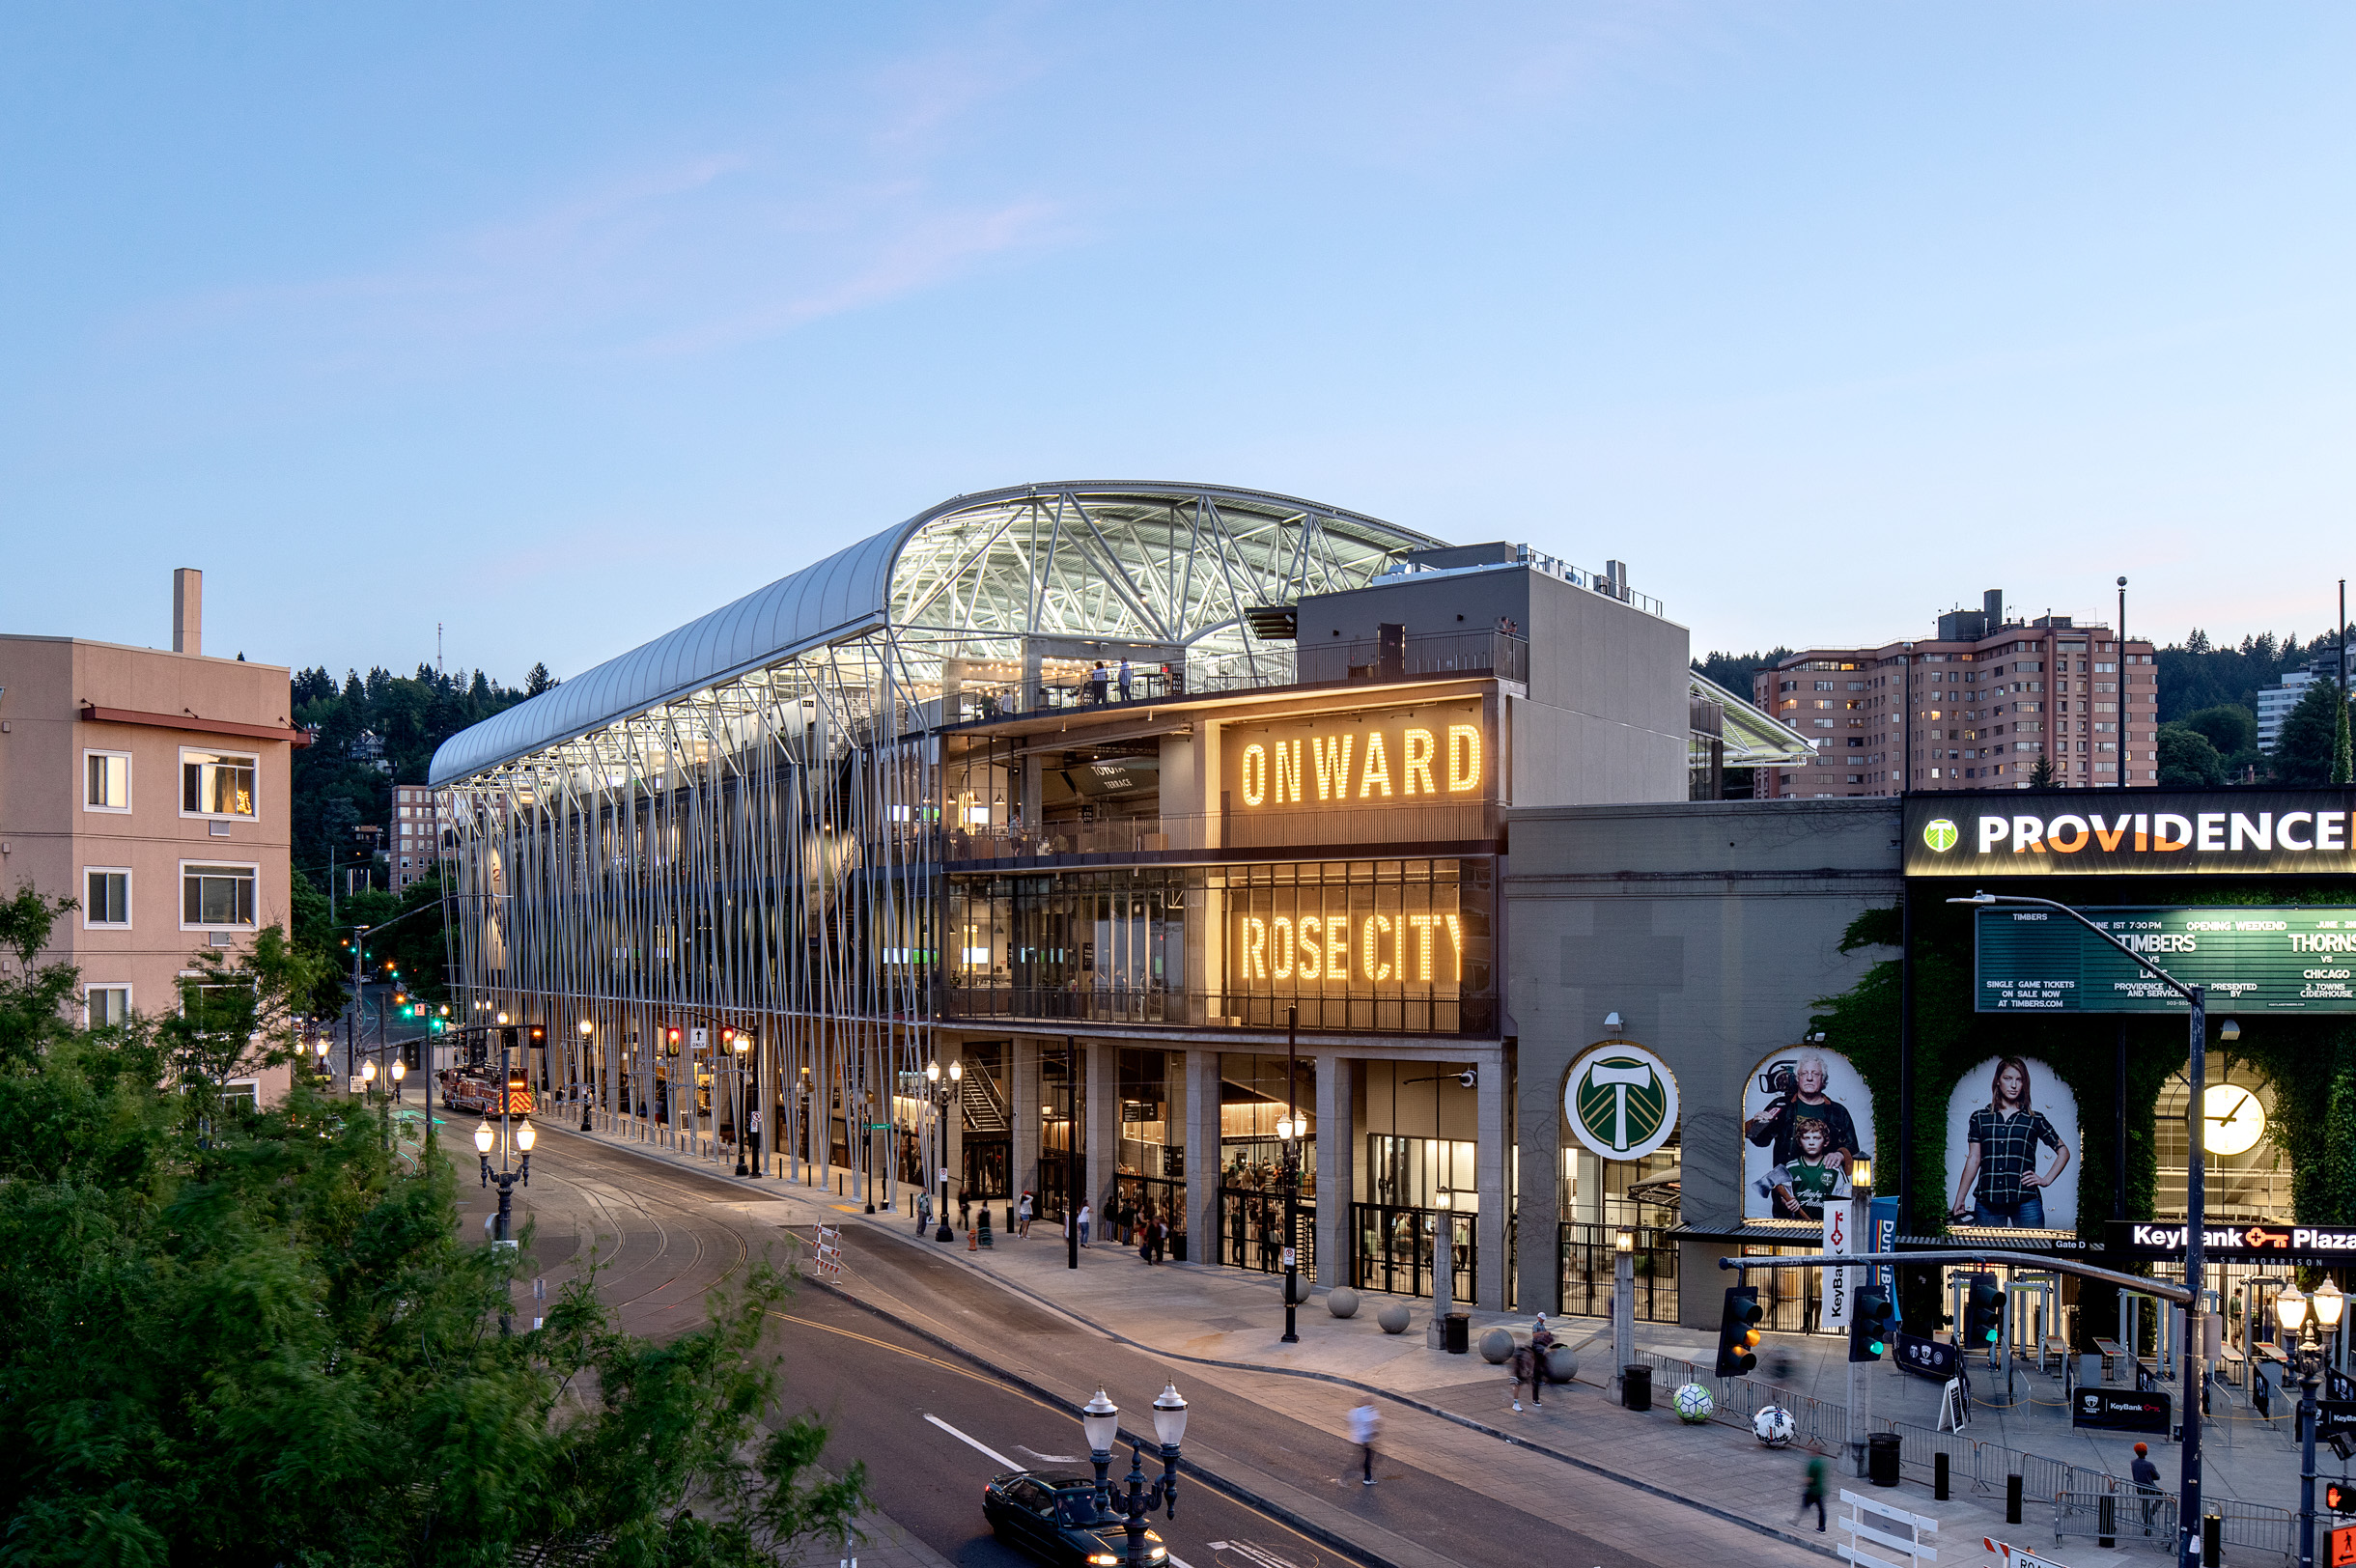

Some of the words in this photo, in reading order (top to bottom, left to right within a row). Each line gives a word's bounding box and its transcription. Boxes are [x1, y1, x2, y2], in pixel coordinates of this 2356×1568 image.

[1242, 724, 1481, 807] ONWARD
[1104, 778, 1132, 789] TERRACE
[1978, 811, 2345, 854] PROVIDENCE
[2186, 921, 2231, 931] OPENING
[2235, 920, 2287, 931] WEEKEND
[2315, 920, 2339, 929] JUNE
[1242, 915, 1348, 981] ROSE
[1363, 913, 1461, 982] CITY
[2117, 934, 2197, 953] TIMBERS
[2147, 955, 2160, 964] VS
[2320, 955, 2333, 964] VS
[2303, 968, 2351, 979] CHICAGO
[2114, 982, 2164, 991] PROVIDENCE
[2169, 982, 2200, 991] ALTH
[2210, 983, 2258, 992] PRESENTED
[2300, 990, 2353, 998] CIDERHOUSE
[2056, 1240, 2077, 1248] Gate
[2292, 1229, 2356, 1249] Plaza
[1880, 1219, 1894, 1272] DUTH
[2174, 1255, 2209, 1264] 184
[2249, 1257, 2323, 1267] MORRISON
[1831, 1248, 1844, 1318] KeyBak
[2110, 1402, 2143, 1412] KeyBank
